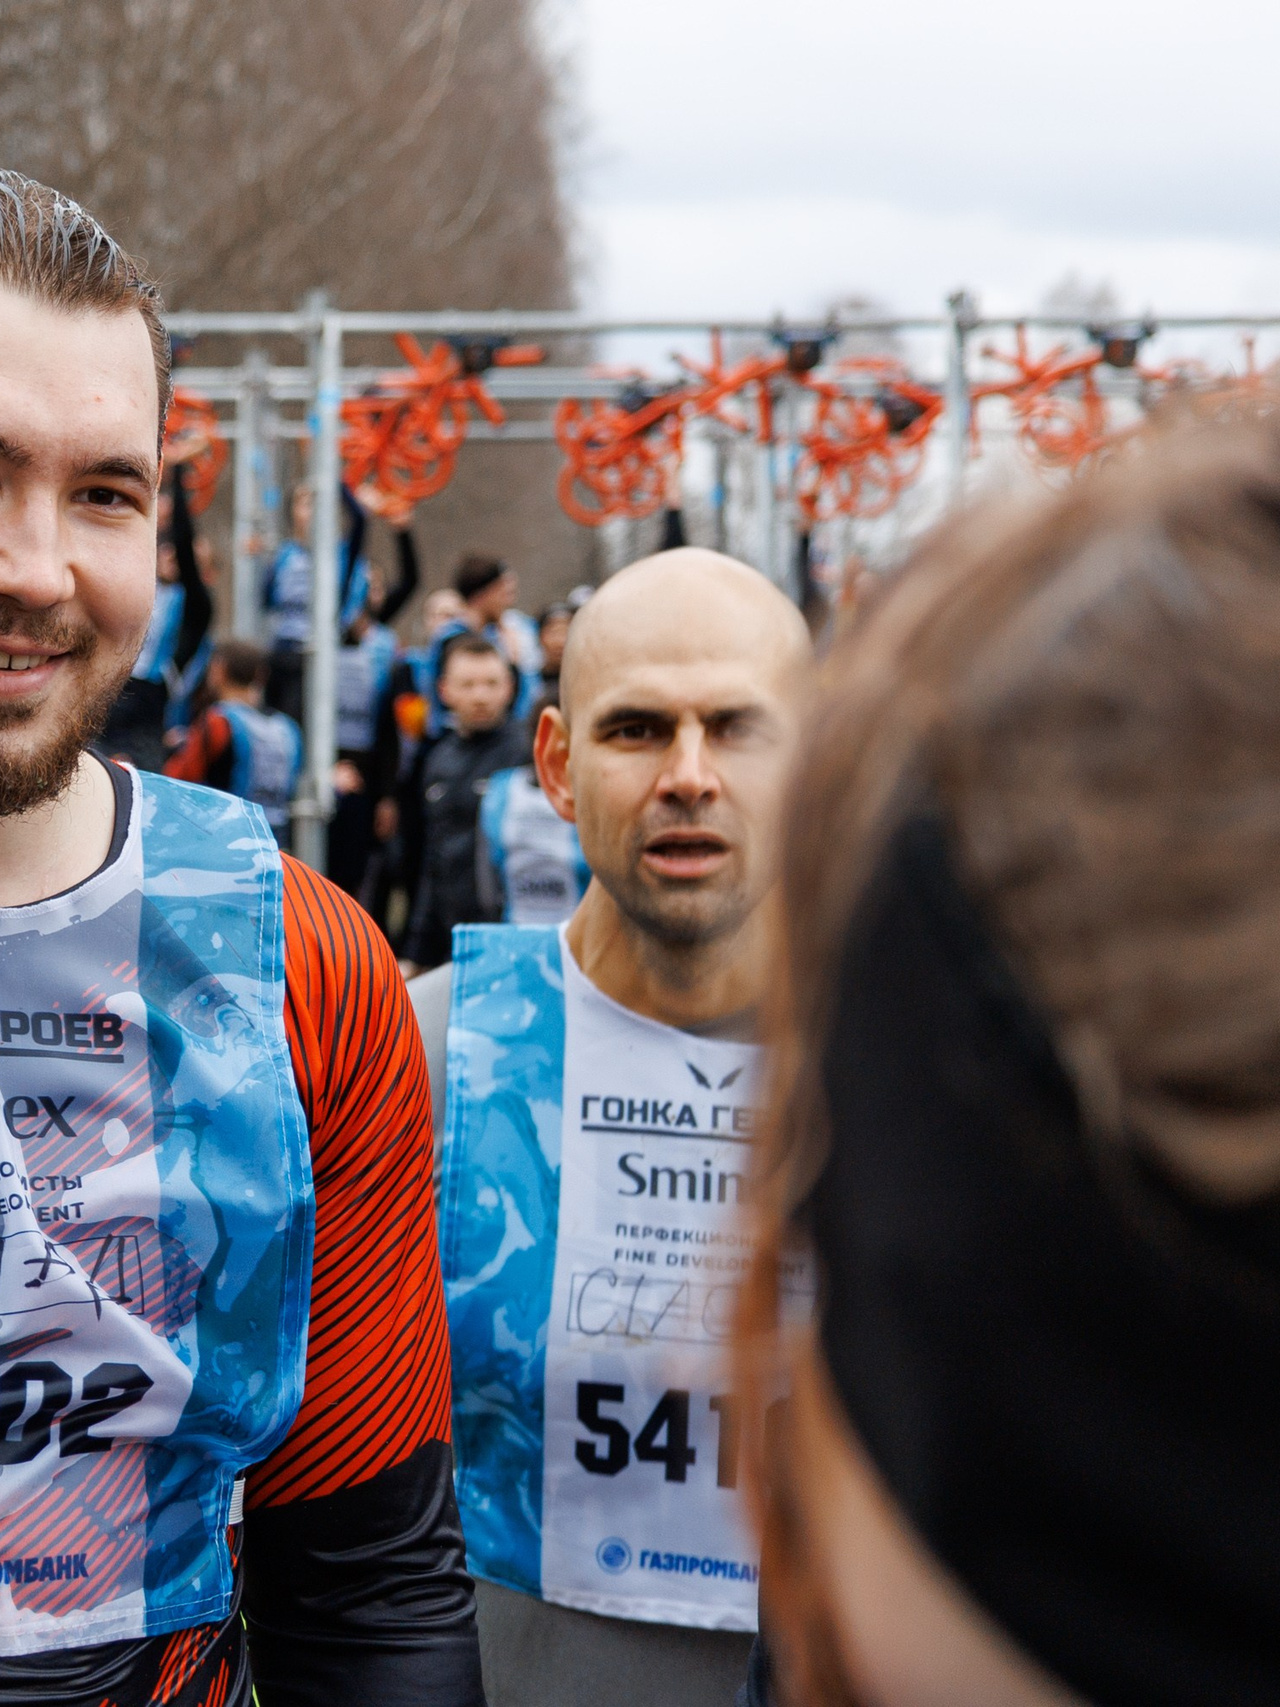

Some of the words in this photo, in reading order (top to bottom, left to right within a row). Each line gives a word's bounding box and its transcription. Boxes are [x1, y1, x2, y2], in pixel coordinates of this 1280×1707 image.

[581, 1095, 699, 1129] ГОНКА
[618, 1152, 747, 1204] Smin
[614, 1248, 657, 1265] FINE
[575, 1381, 770, 1490] 541
[639, 1549, 759, 1582] ГАЗПРОМБА
